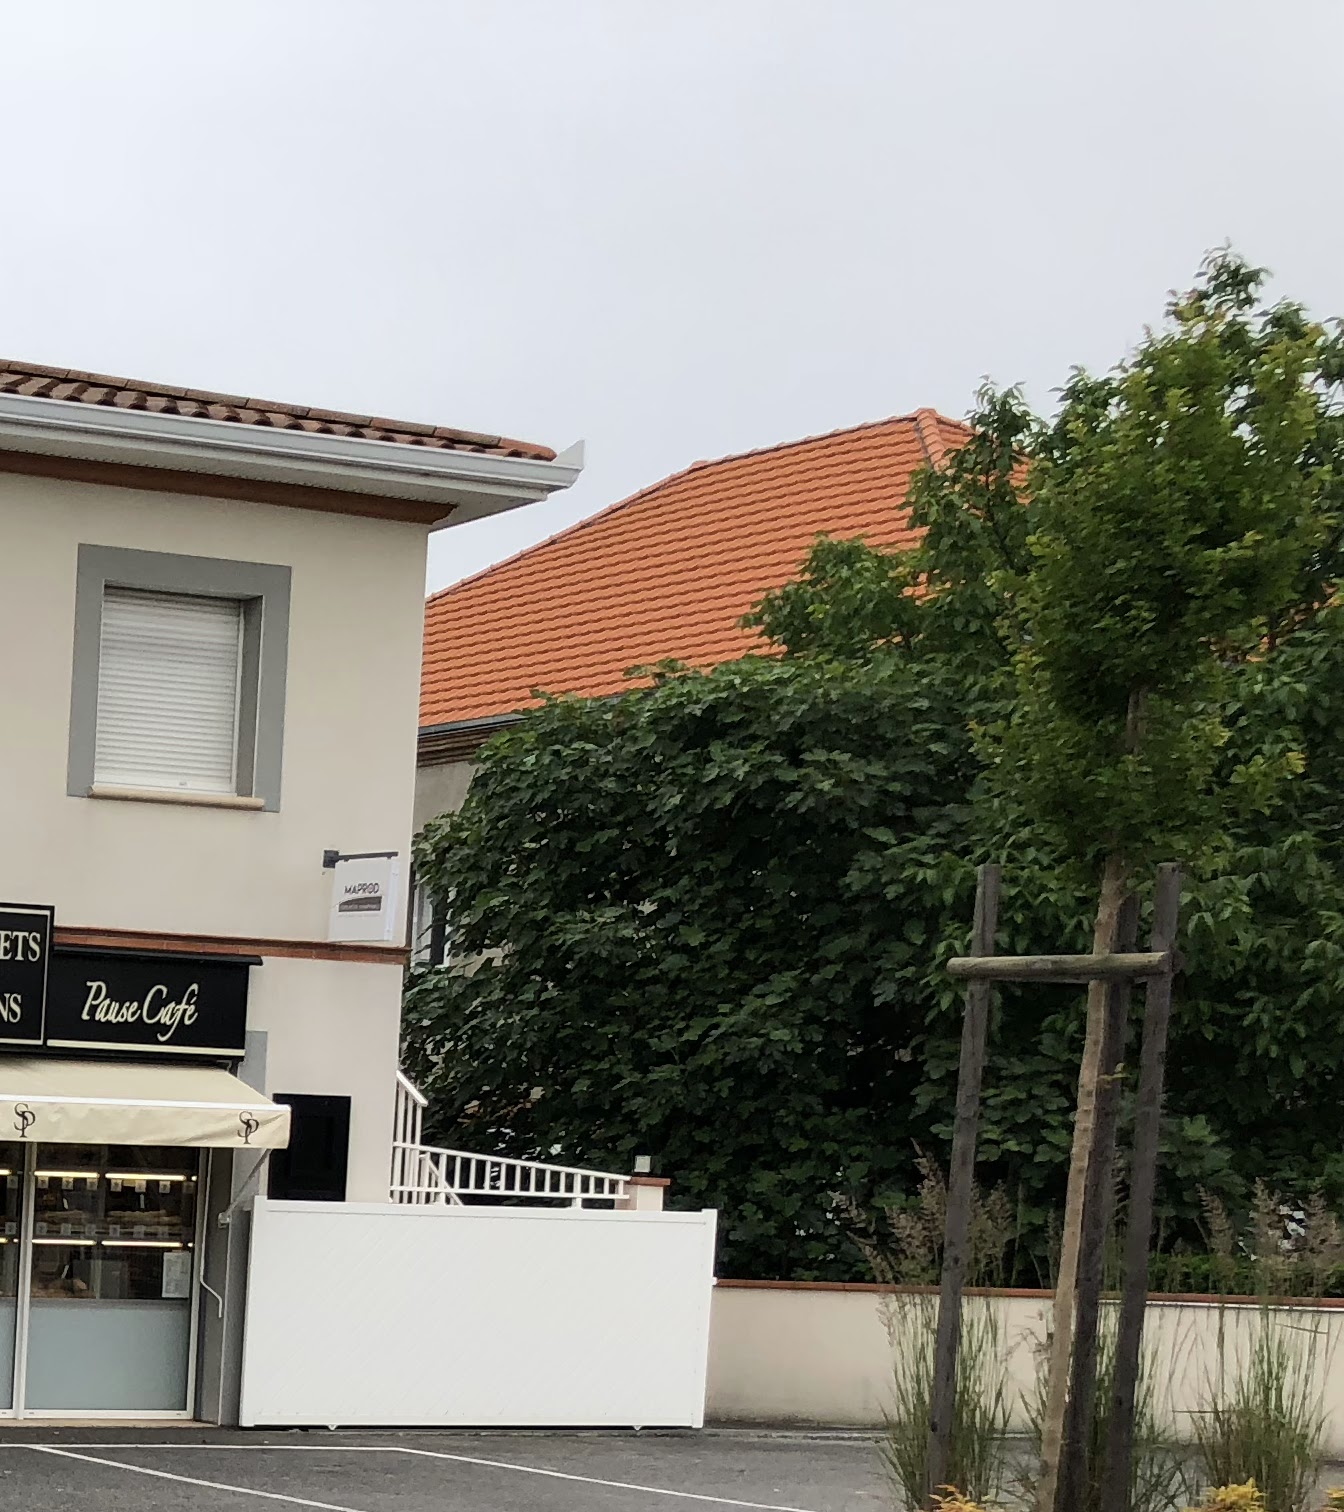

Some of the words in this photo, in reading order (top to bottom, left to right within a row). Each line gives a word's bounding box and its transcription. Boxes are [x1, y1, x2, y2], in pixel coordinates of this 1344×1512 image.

[344, 883, 380, 895] MAPROD
[81, 980, 140, 1023] Pause
[141, 984, 199, 1042] Café
